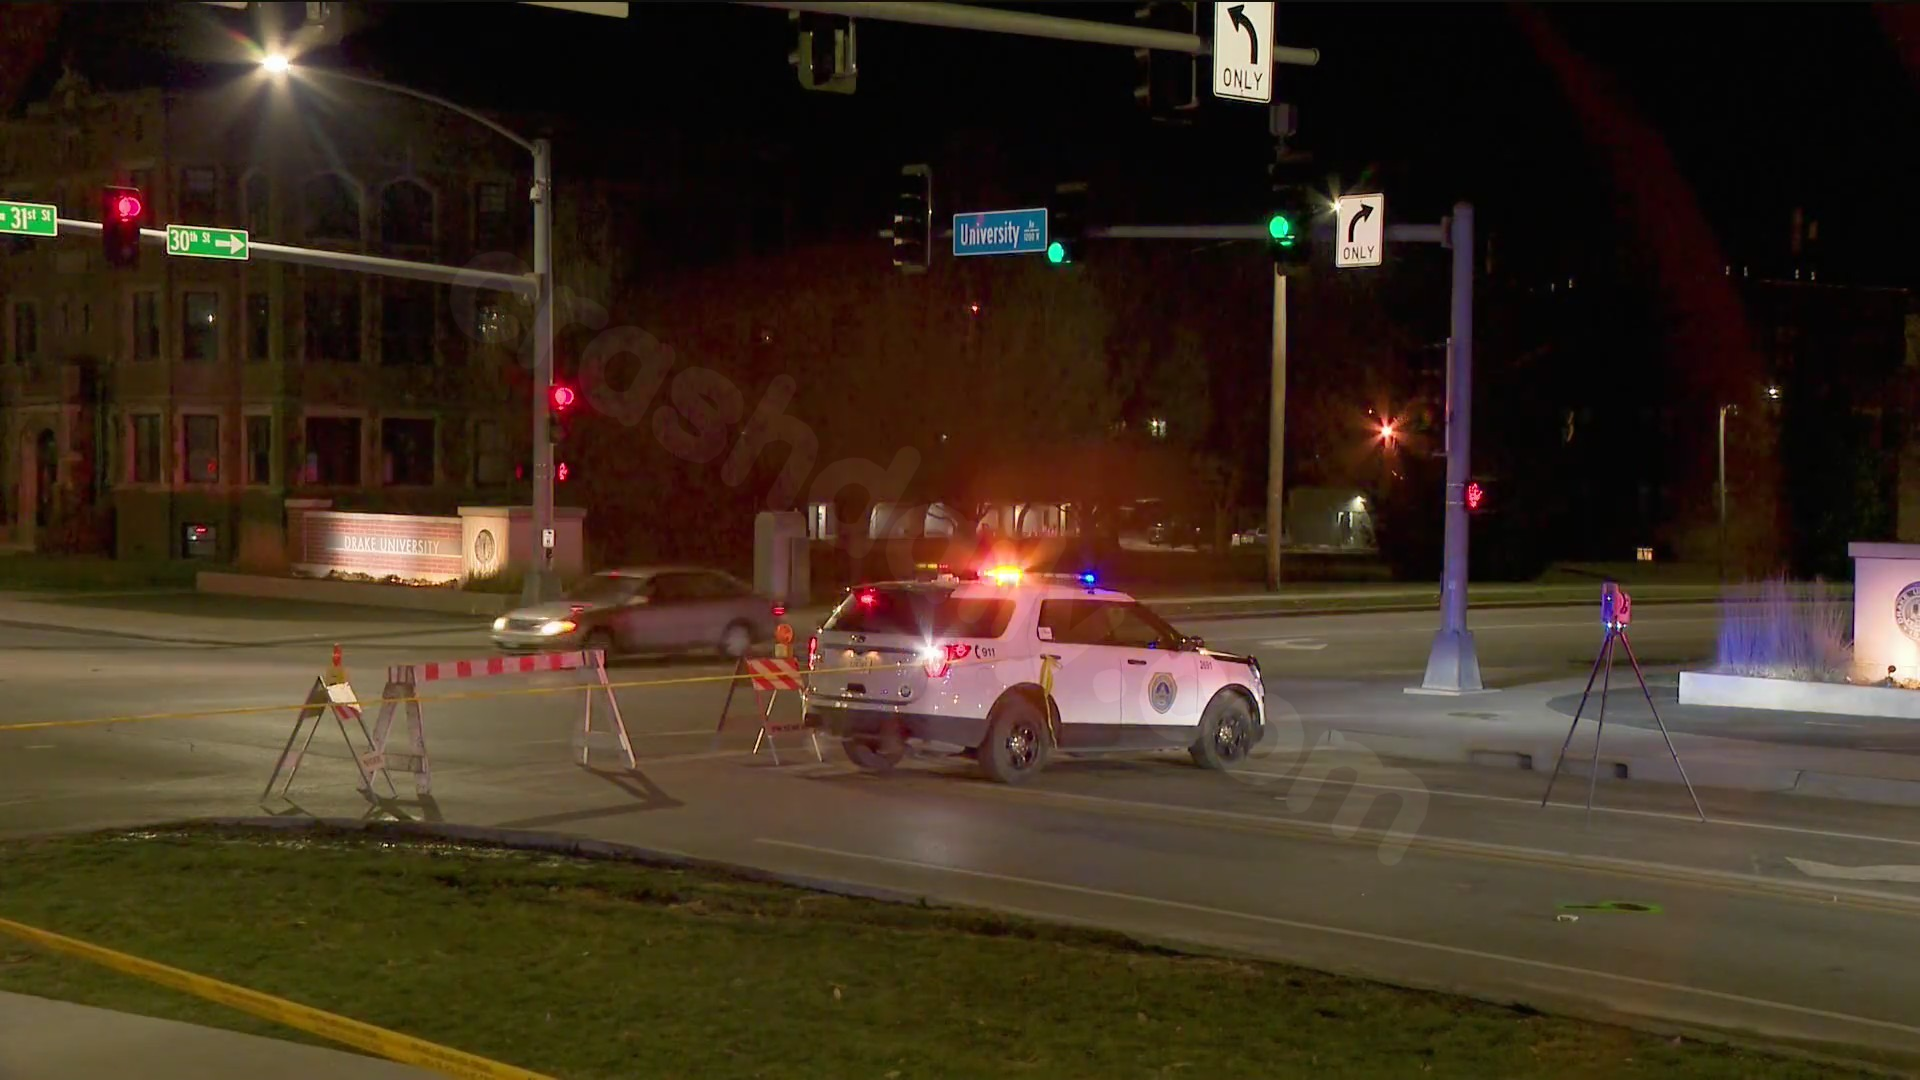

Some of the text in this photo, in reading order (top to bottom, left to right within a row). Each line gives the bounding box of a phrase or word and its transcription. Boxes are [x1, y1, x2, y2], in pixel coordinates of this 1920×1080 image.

[1223, 68, 1263, 91] ONLY
[11, 207, 51, 230] 31st St
[170, 230, 212, 252] 30th St
[960, 220, 1020, 249] University
[1343, 245, 1375, 260] ONLY
[344, 535, 440, 555] DRAKE UNIVERSITY
[981, 647, 996, 657] 911
